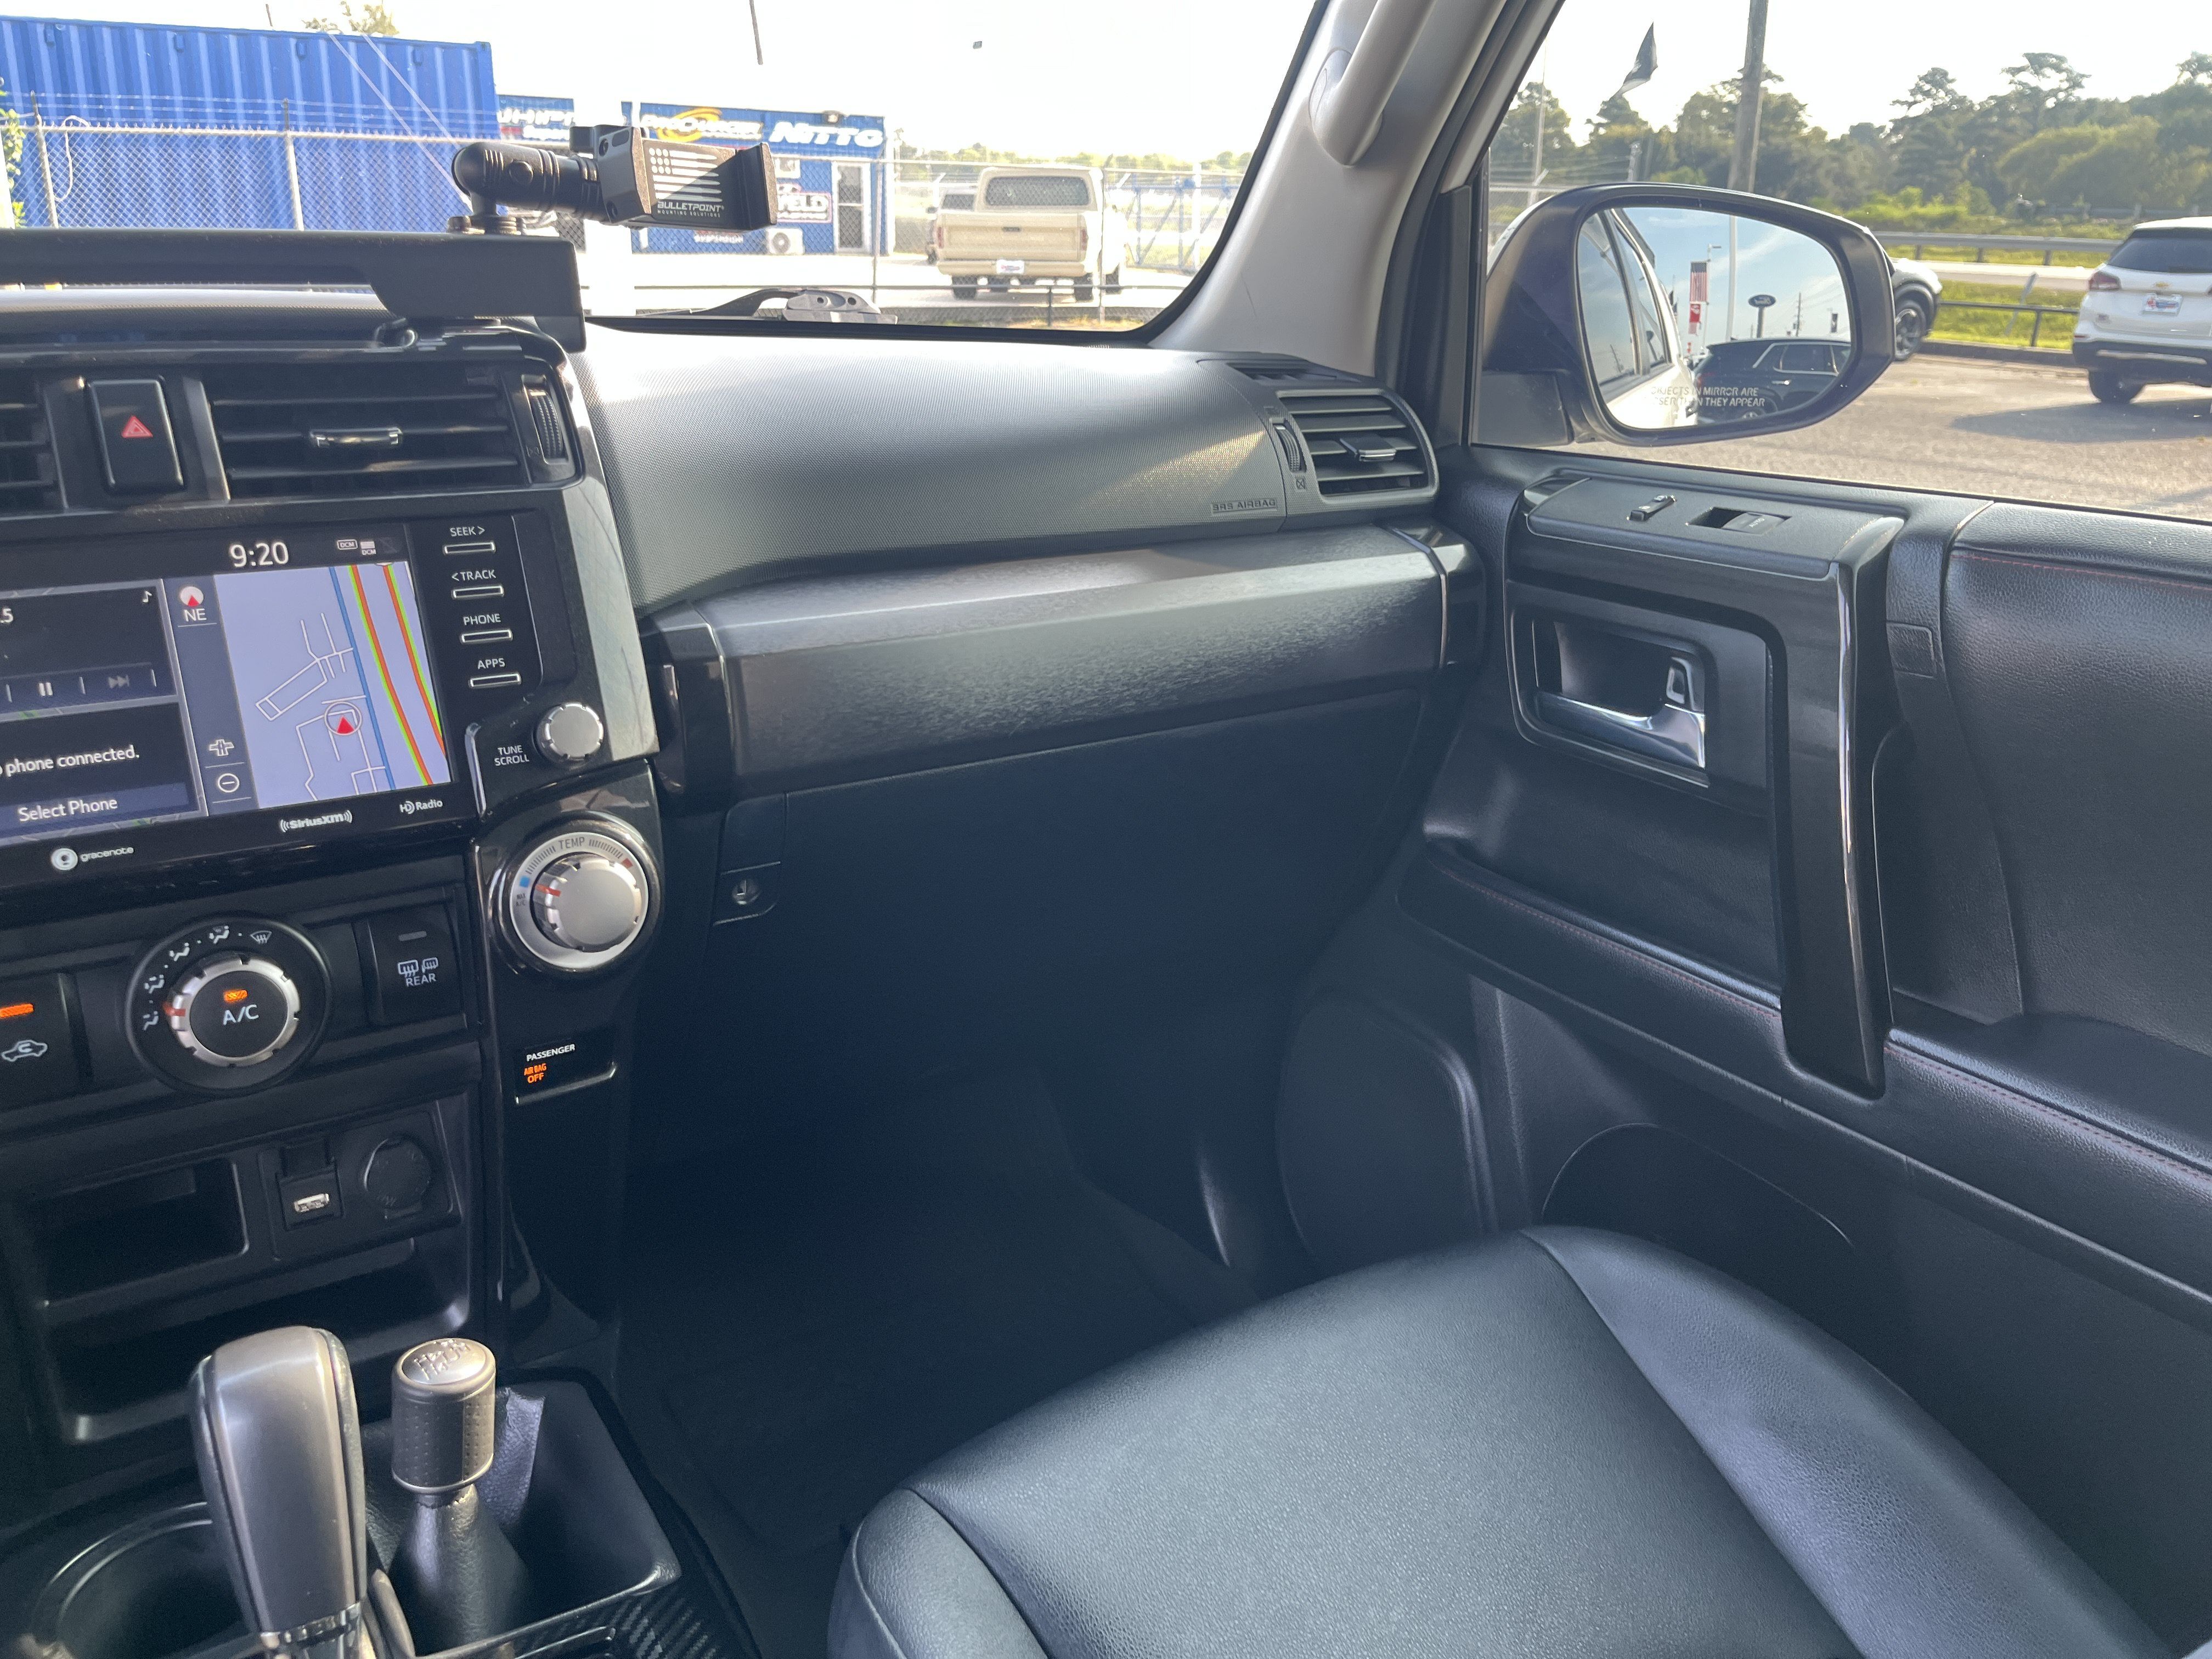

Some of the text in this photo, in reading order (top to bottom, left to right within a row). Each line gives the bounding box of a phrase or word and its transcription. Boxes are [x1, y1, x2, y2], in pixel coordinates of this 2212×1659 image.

[769, 121, 883, 148] NITTO
[658, 201, 722, 212] BULLETPOINT
[1703, 387, 1737, 396] MIRROR
[1741, 387, 1759, 396] ARE
[1705, 397, 1728, 407] THEY
[1729, 398, 1765, 407] APPEAR
[450, 527, 475, 537] SEEK
[230, 542, 289, 567] 9:20
[460, 569, 496, 580] TRACK
[184, 608, 207, 622] NE
[463, 613, 501, 625] PHONE
[477, 658, 505, 669] APPS
[497, 744, 523, 755] TUNE
[5, 758, 54, 777] phone
[57, 744, 140, 768] connected.
[494, 754, 529, 766] SCROLL
[18, 799, 118, 822] Select Phone
[416, 799, 443, 811] Radio
[558, 837, 585, 850] TEMP
[80, 847, 134, 862] gracenote
[406, 973, 436, 987] REAR
[223, 1004, 259, 1026] A/C
[527, 1044, 575, 1062] PASSENGER
[527, 1072, 544, 1084] OFF
